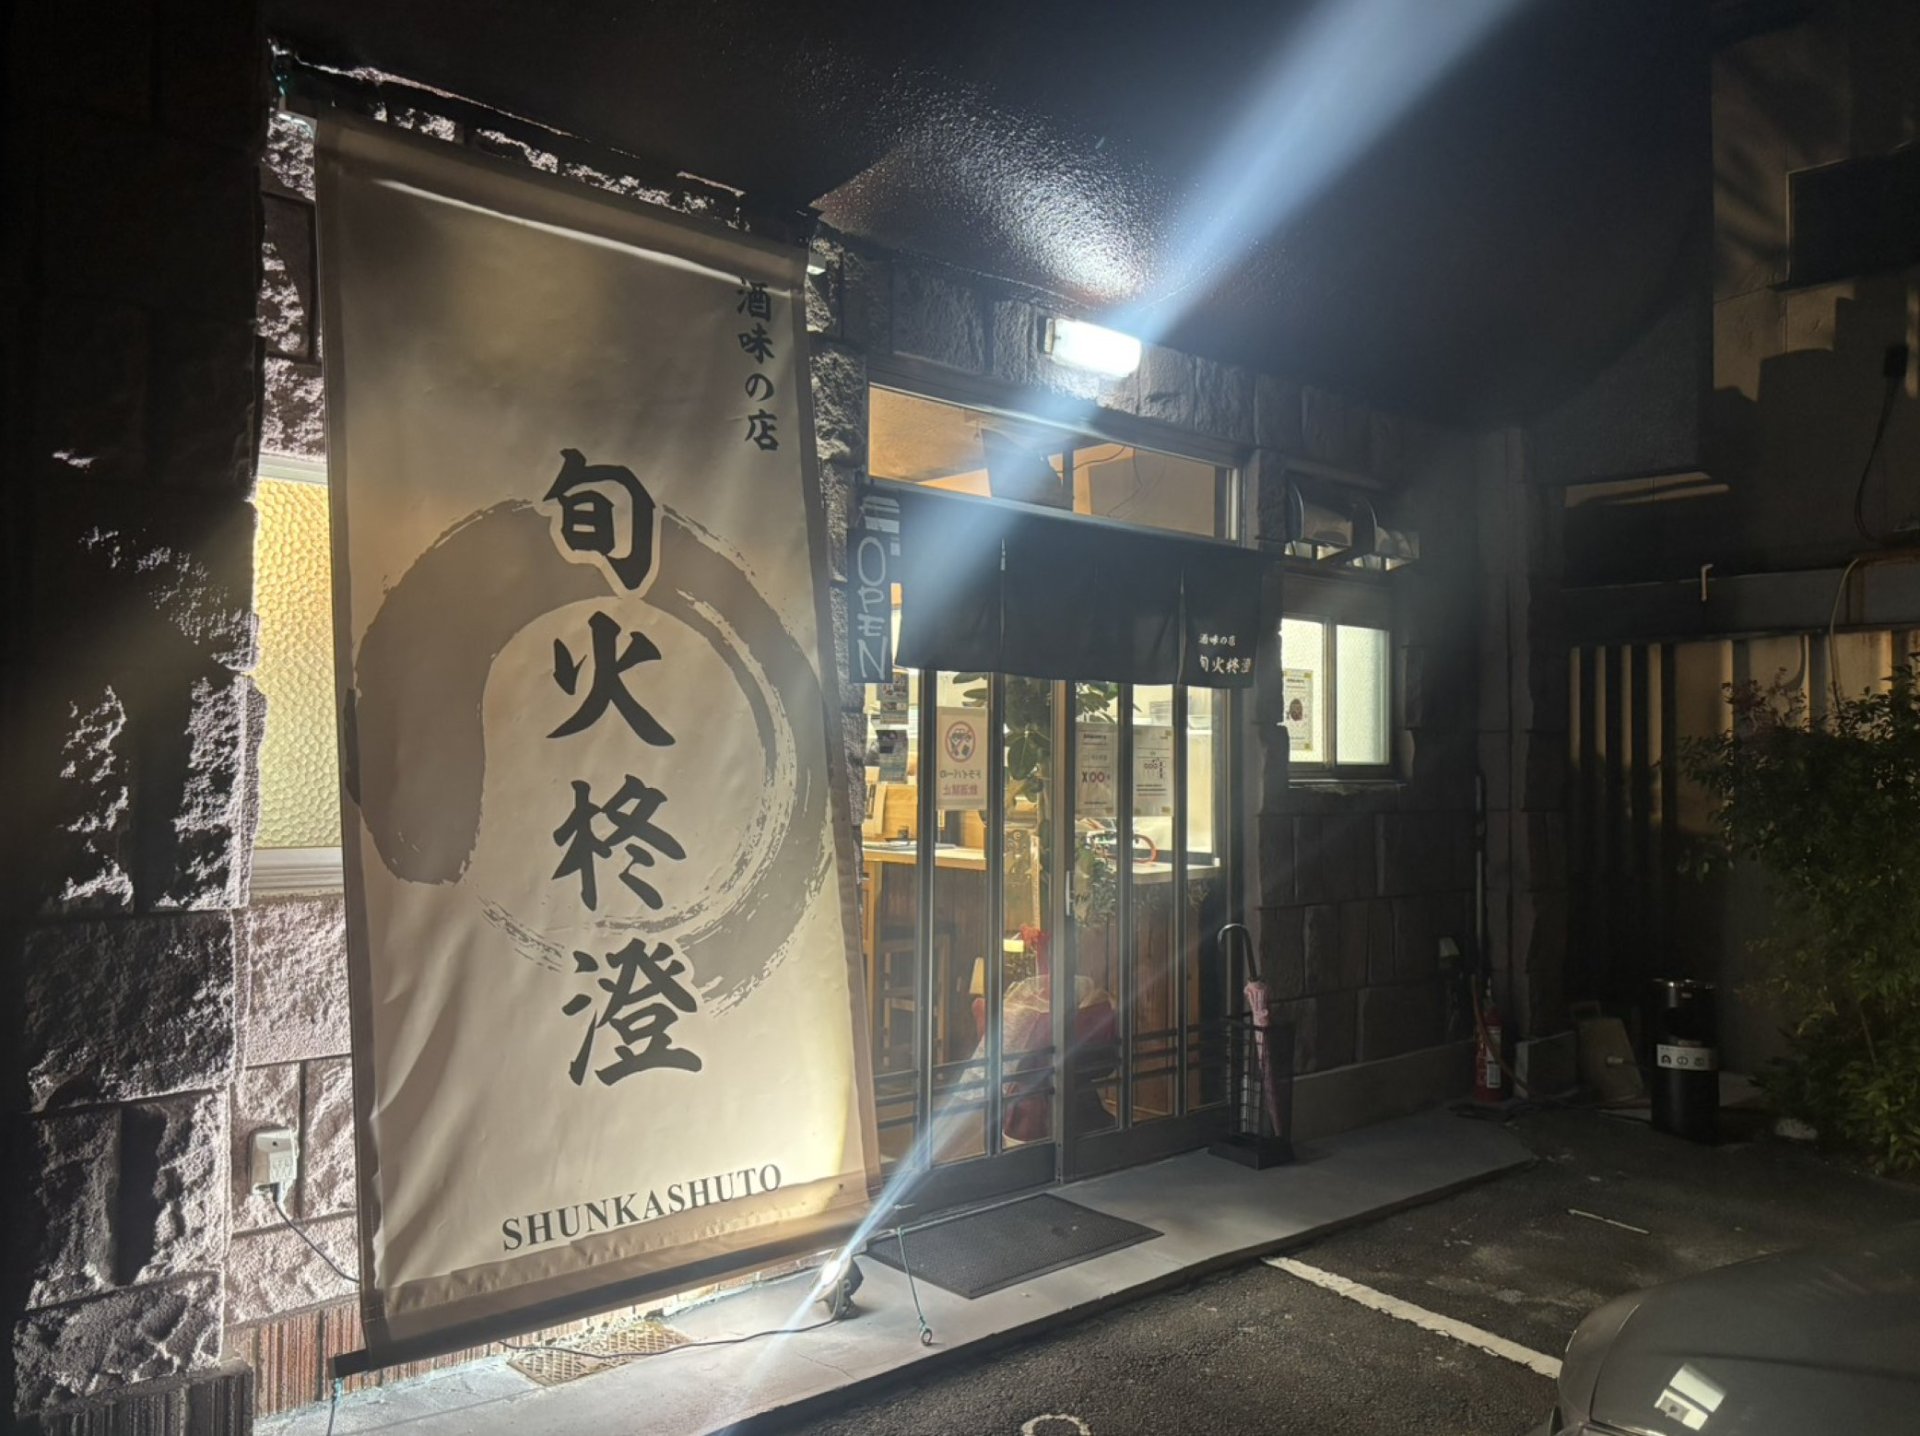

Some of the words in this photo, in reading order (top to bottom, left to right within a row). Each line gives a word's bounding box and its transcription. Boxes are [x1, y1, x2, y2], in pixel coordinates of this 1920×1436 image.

[736, 277, 779, 451] 酒味の店
[857, 536, 888, 681] OPEN
[543, 448, 702, 1086] 旬火柊澄
[501, 1163, 782, 1252] SHUNKASHUTO
